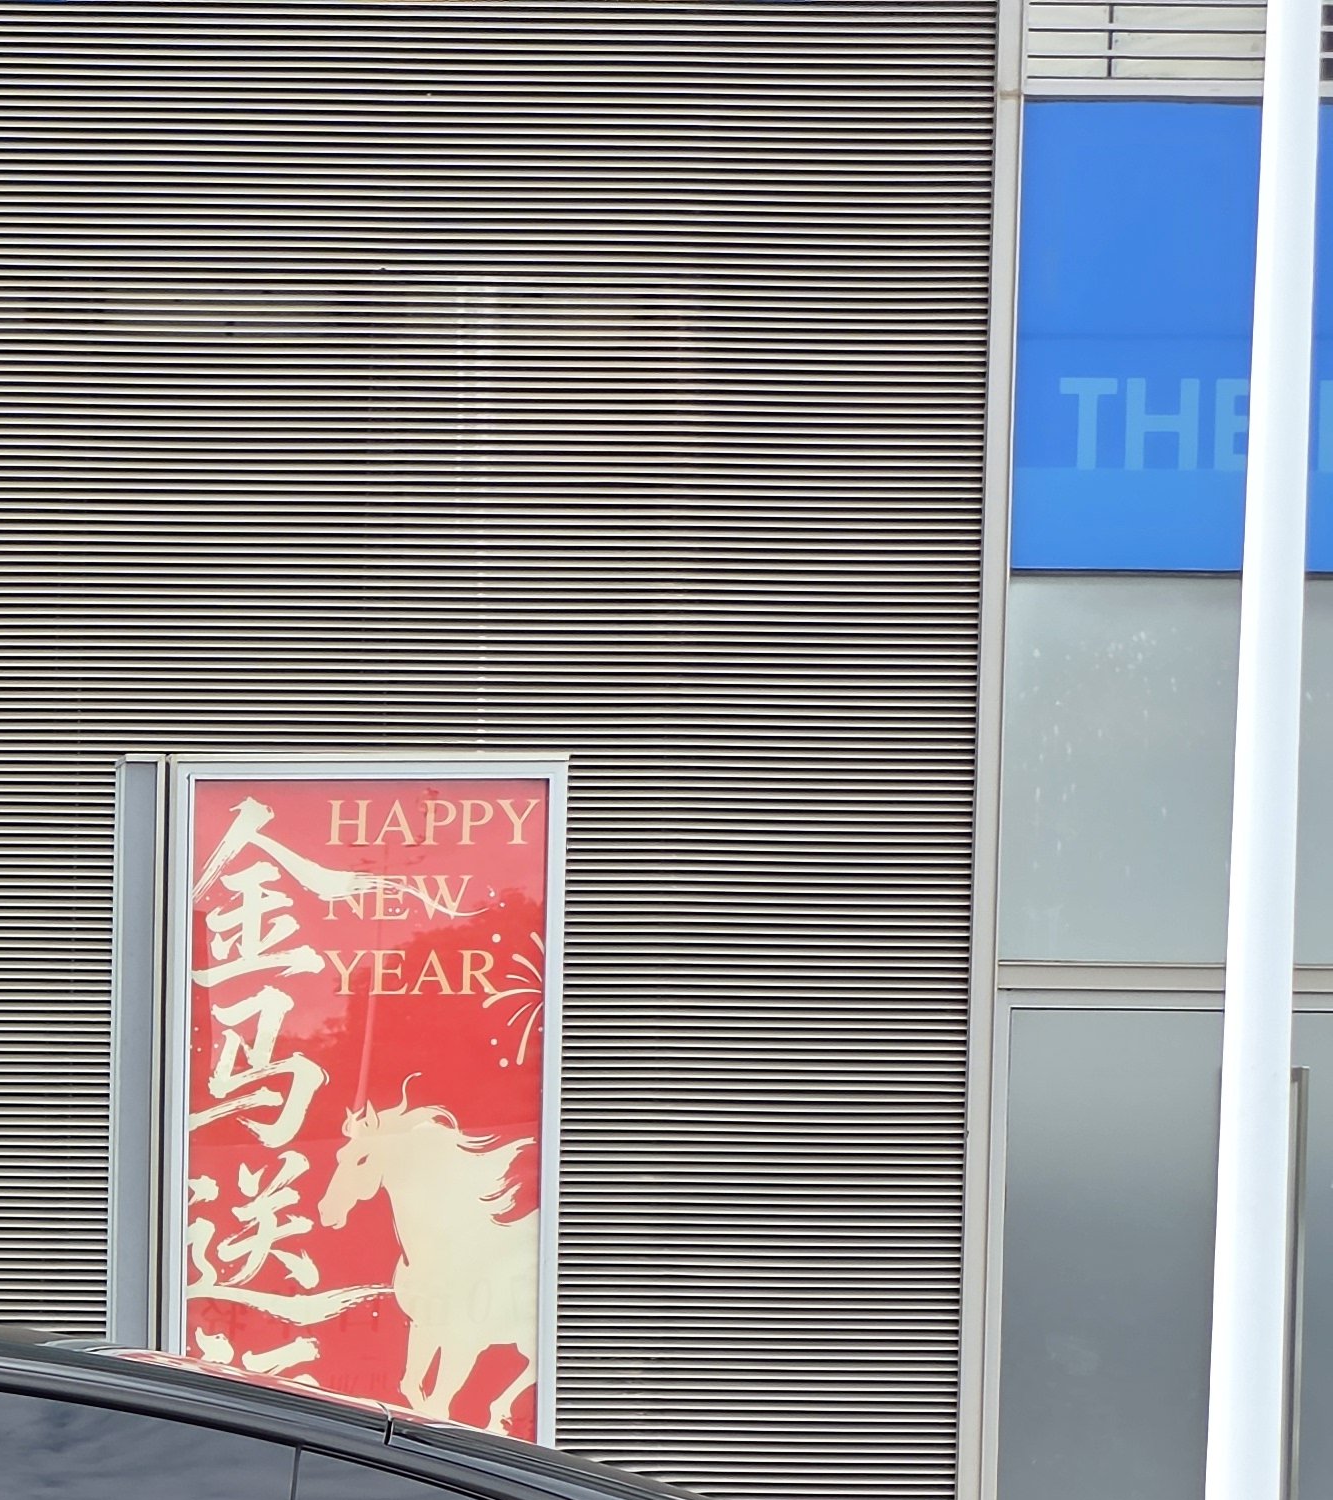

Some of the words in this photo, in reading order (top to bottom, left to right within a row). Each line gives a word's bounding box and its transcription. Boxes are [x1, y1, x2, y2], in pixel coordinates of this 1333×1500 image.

[1059, 377, 1249, 470] THE
[325, 798, 541, 846] HAPPY
[322, 874, 473, 921] NEW
[322, 949, 499, 996] YEAR
